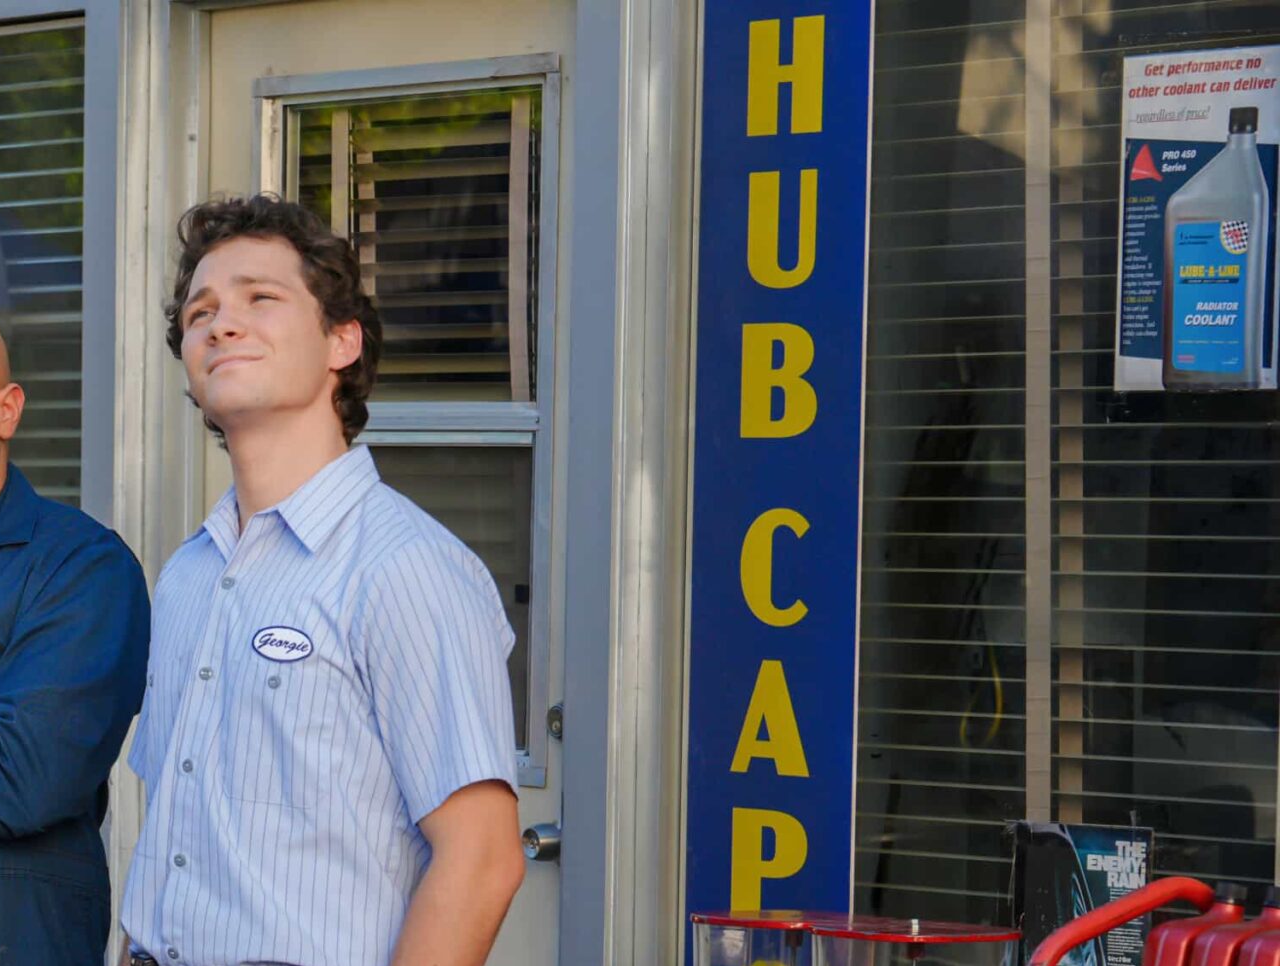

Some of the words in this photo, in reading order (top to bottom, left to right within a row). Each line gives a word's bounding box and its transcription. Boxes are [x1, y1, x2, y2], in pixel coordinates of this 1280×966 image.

[1145, 63, 1165, 76] Get
[1167, 58, 1243, 78] performance
[1246, 57, 1262, 69] no
[1128, 84, 1160, 98] other
[1163, 81, 1207, 96] coolant
[1210, 80, 1230, 93] can
[1233, 77, 1277, 91] deliver
[1162, 151, 1180, 161] PRO
[1181, 149, 1197, 159] 450
[1161, 163, 1187, 173] Series
[740, 15, 825, 440] HUB
[1196, 302, 1239, 311] RADIATOR
[1184, 314, 1238, 326] COOLANT
[257, 632, 310, 654] Georgie
[1115, 840, 1147, 858] THE
[1107, 871, 1146, 889] RAIN
